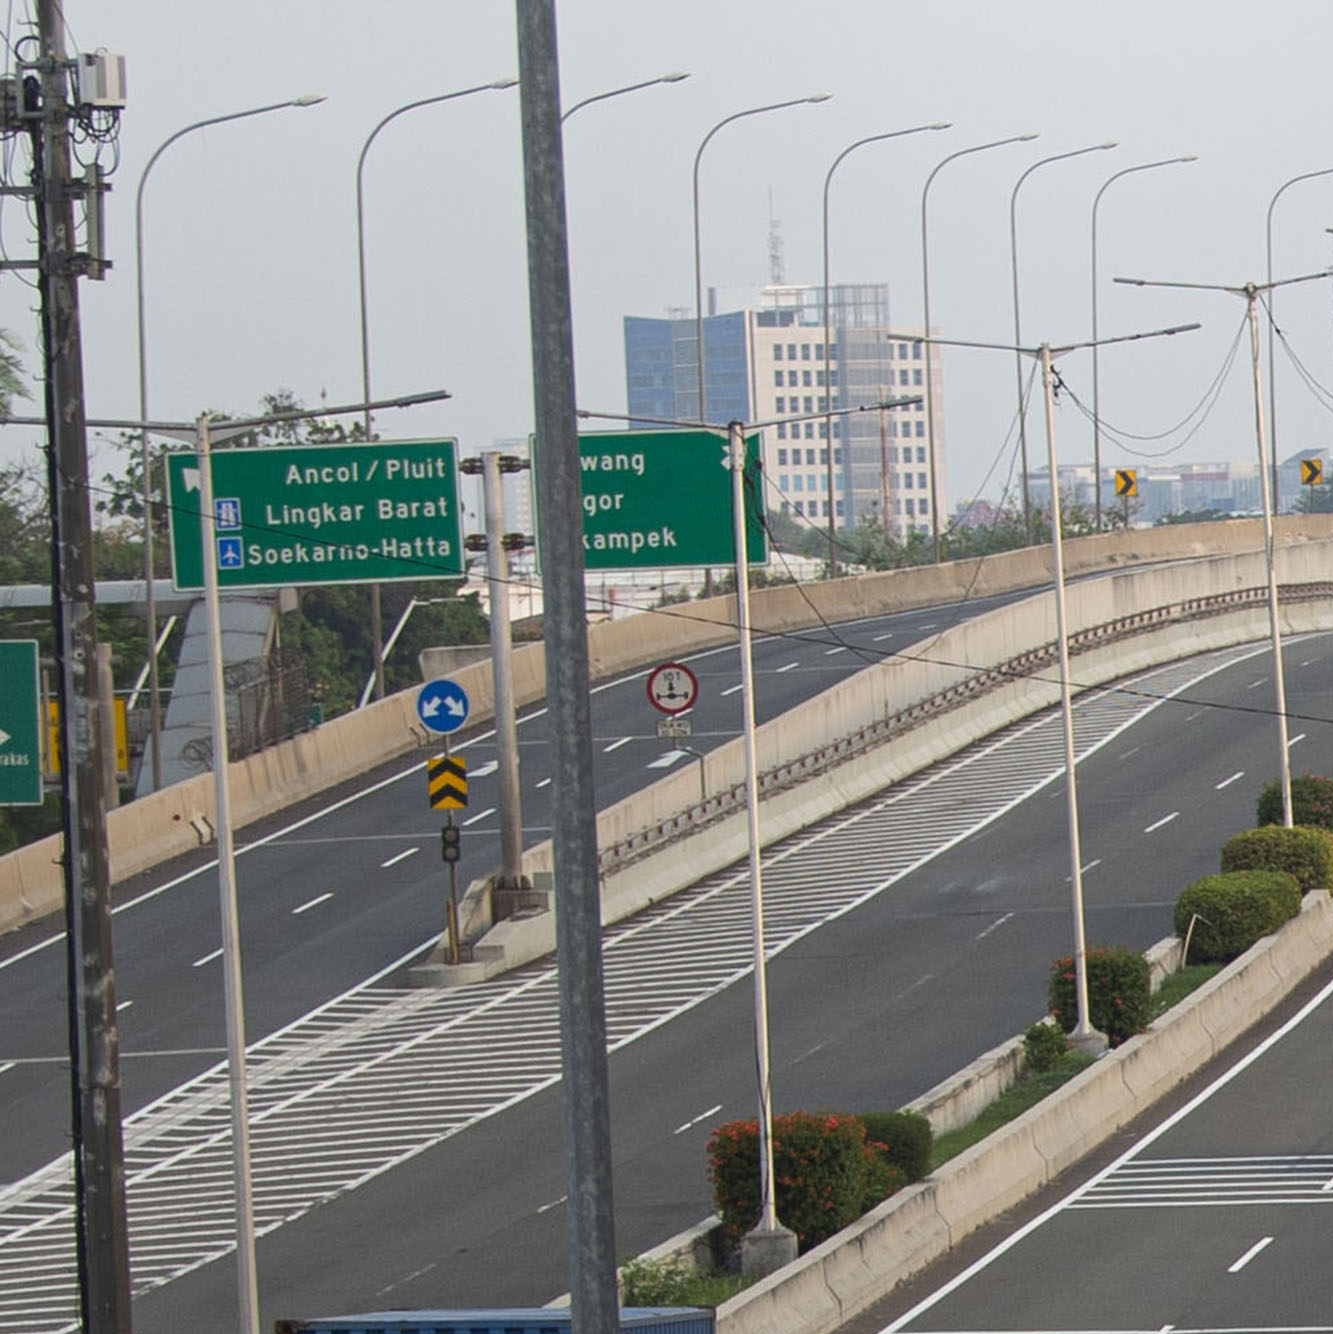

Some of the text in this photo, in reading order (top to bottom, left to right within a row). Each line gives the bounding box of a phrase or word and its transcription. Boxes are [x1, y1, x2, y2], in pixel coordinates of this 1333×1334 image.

[286, 458, 445, 484] Ancol / Pluit
[266, 497, 448, 528] Lingkar Barat
[583, 493, 624, 516] gor
[248, 536, 451, 565] Soekarno-Hatta
